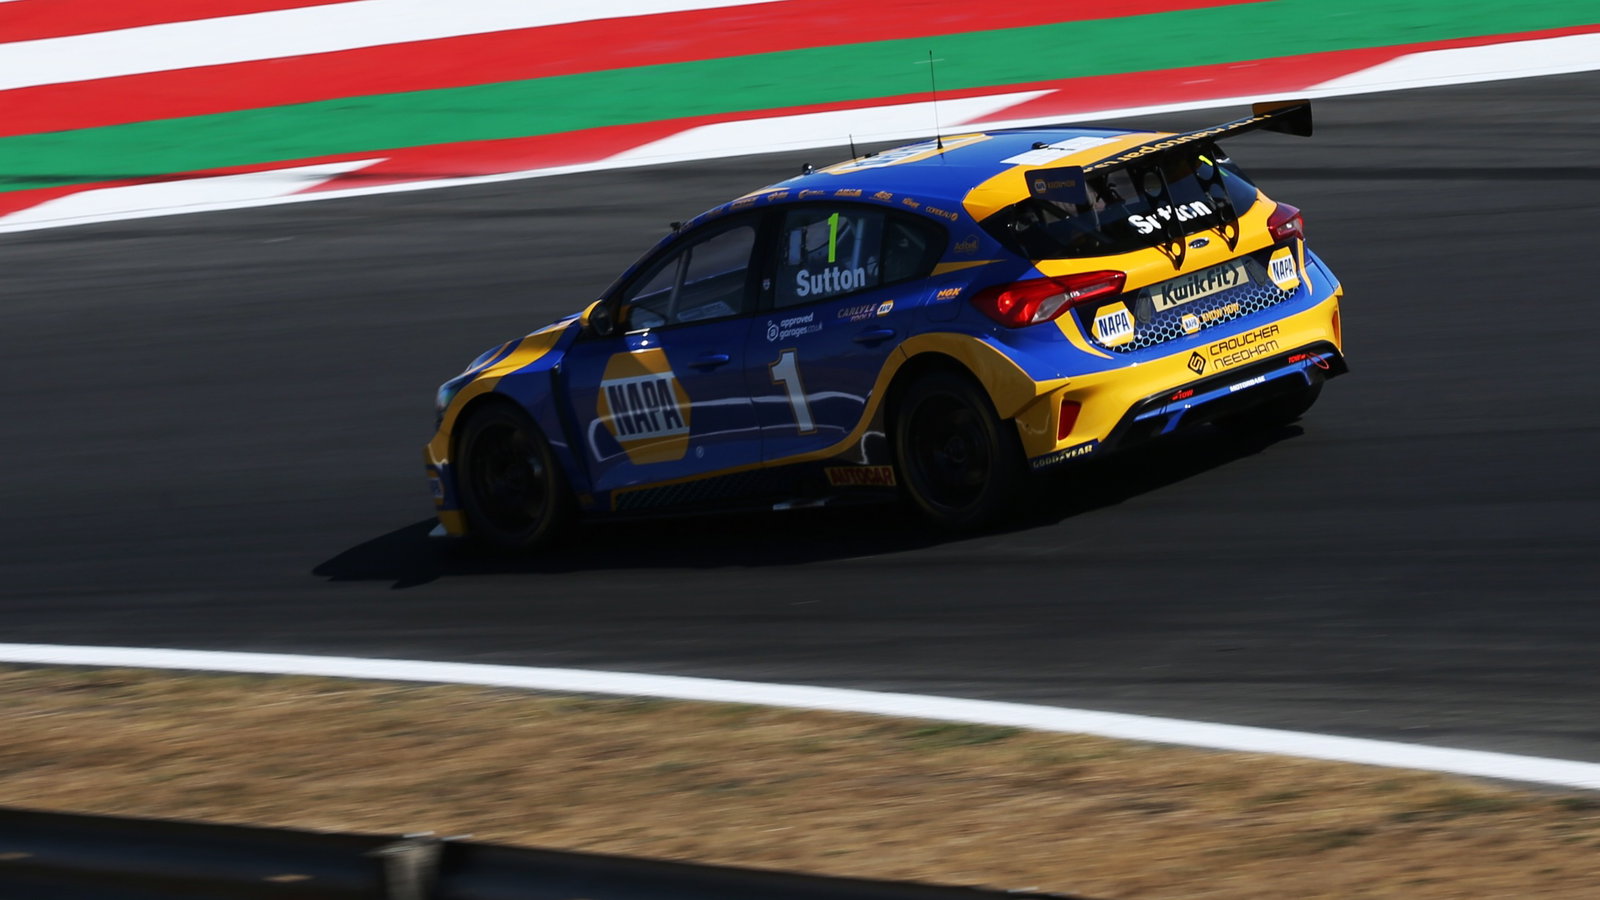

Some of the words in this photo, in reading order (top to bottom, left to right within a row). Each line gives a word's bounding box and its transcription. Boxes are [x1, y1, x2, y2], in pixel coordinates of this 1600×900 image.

[827, 213, 839, 263] 1
[1272, 261, 1293, 281] NAPA
[796, 267, 865, 297] Sutton
[937, 287, 962, 298] NGK
[780, 312, 814, 328] approved
[837, 303, 877, 319] CARLYLE
[1201, 308, 1223, 322] KNOW
[1224, 303, 1240, 316] HOW
[1098, 311, 1131, 337] NAPA
[1209, 324, 1280, 356] CROUCHER
[1214, 340, 1280, 370] NEEDHAM
[1288, 354, 1301, 364] TOW
[768, 348, 817, 435] 1
[1179, 389, 1194, 399] TOW
[1229, 376, 1266, 392] MOTORBASE
[607, 377, 683, 437] NAPA
[1033, 444, 1093, 468] GOODYEAR
[829, 465, 894, 485] AUTOCAR
